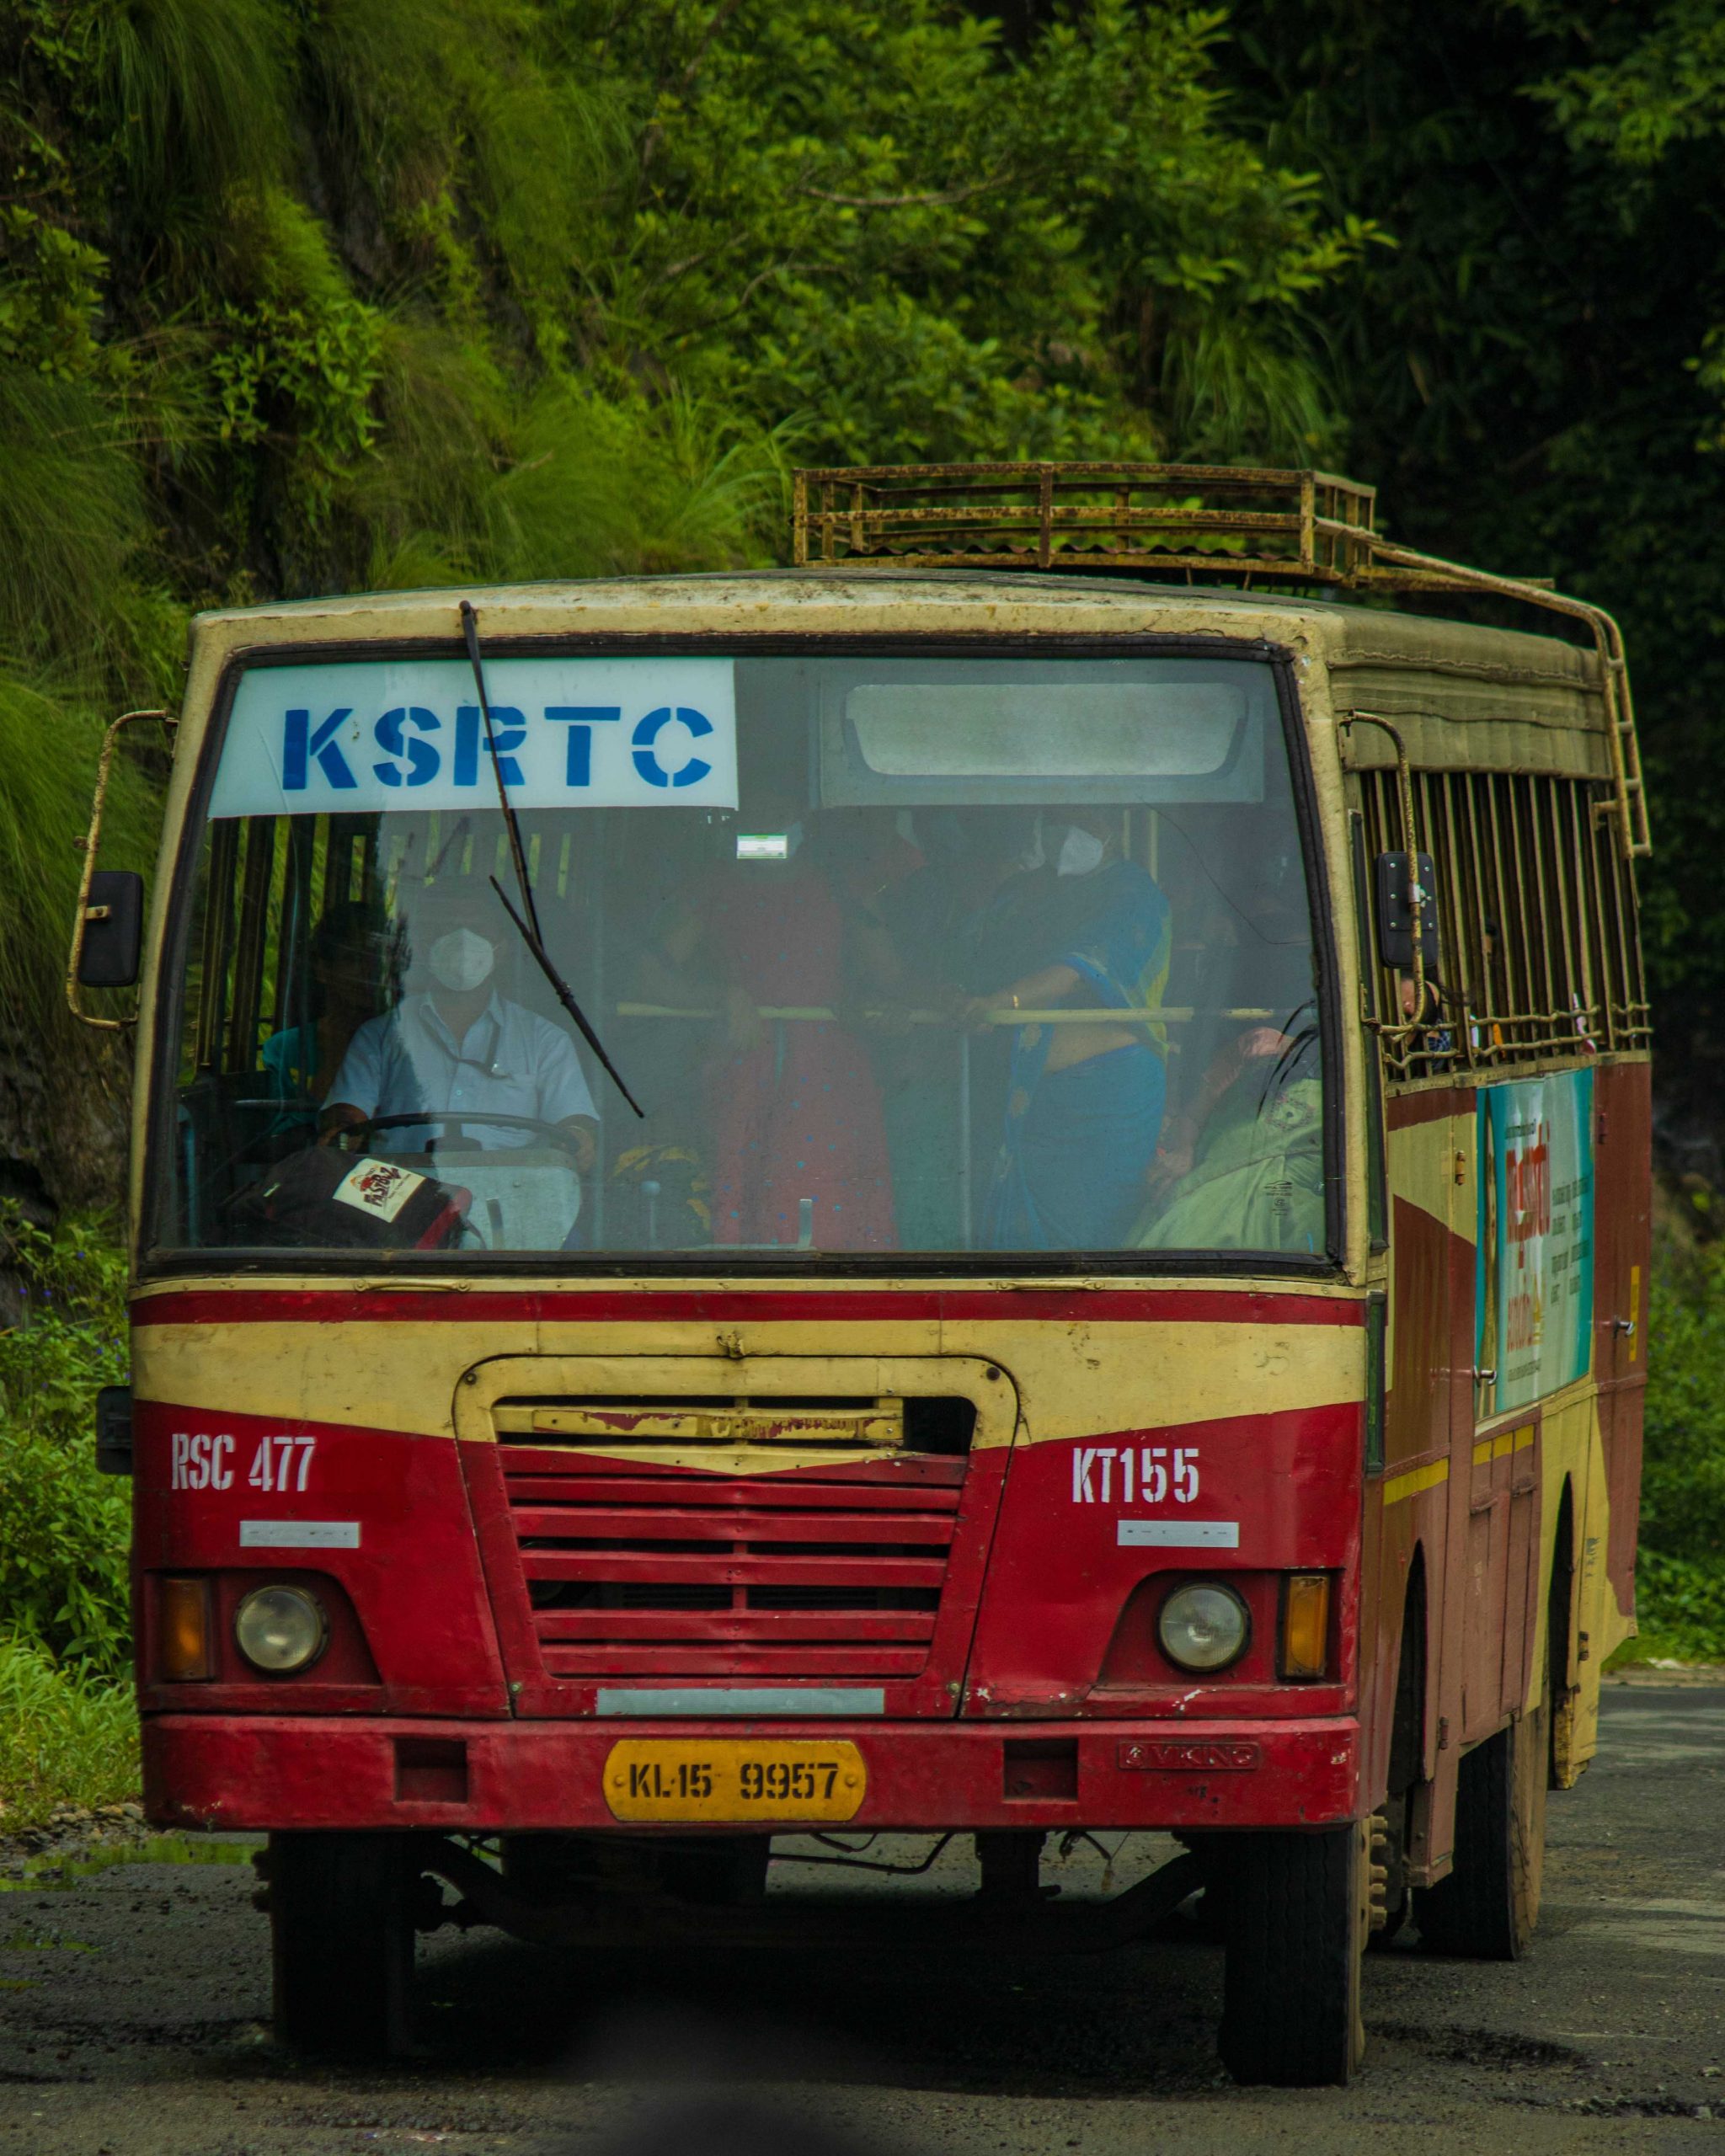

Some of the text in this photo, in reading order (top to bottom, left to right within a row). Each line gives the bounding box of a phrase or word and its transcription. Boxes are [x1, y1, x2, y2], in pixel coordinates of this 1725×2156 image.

[282, 706, 714, 791] KSRTC
[171, 1433, 317, 1492] RSC 477
[1072, 1448, 1199, 1503] KT155
[740, 1763, 839, 1800] 9957
